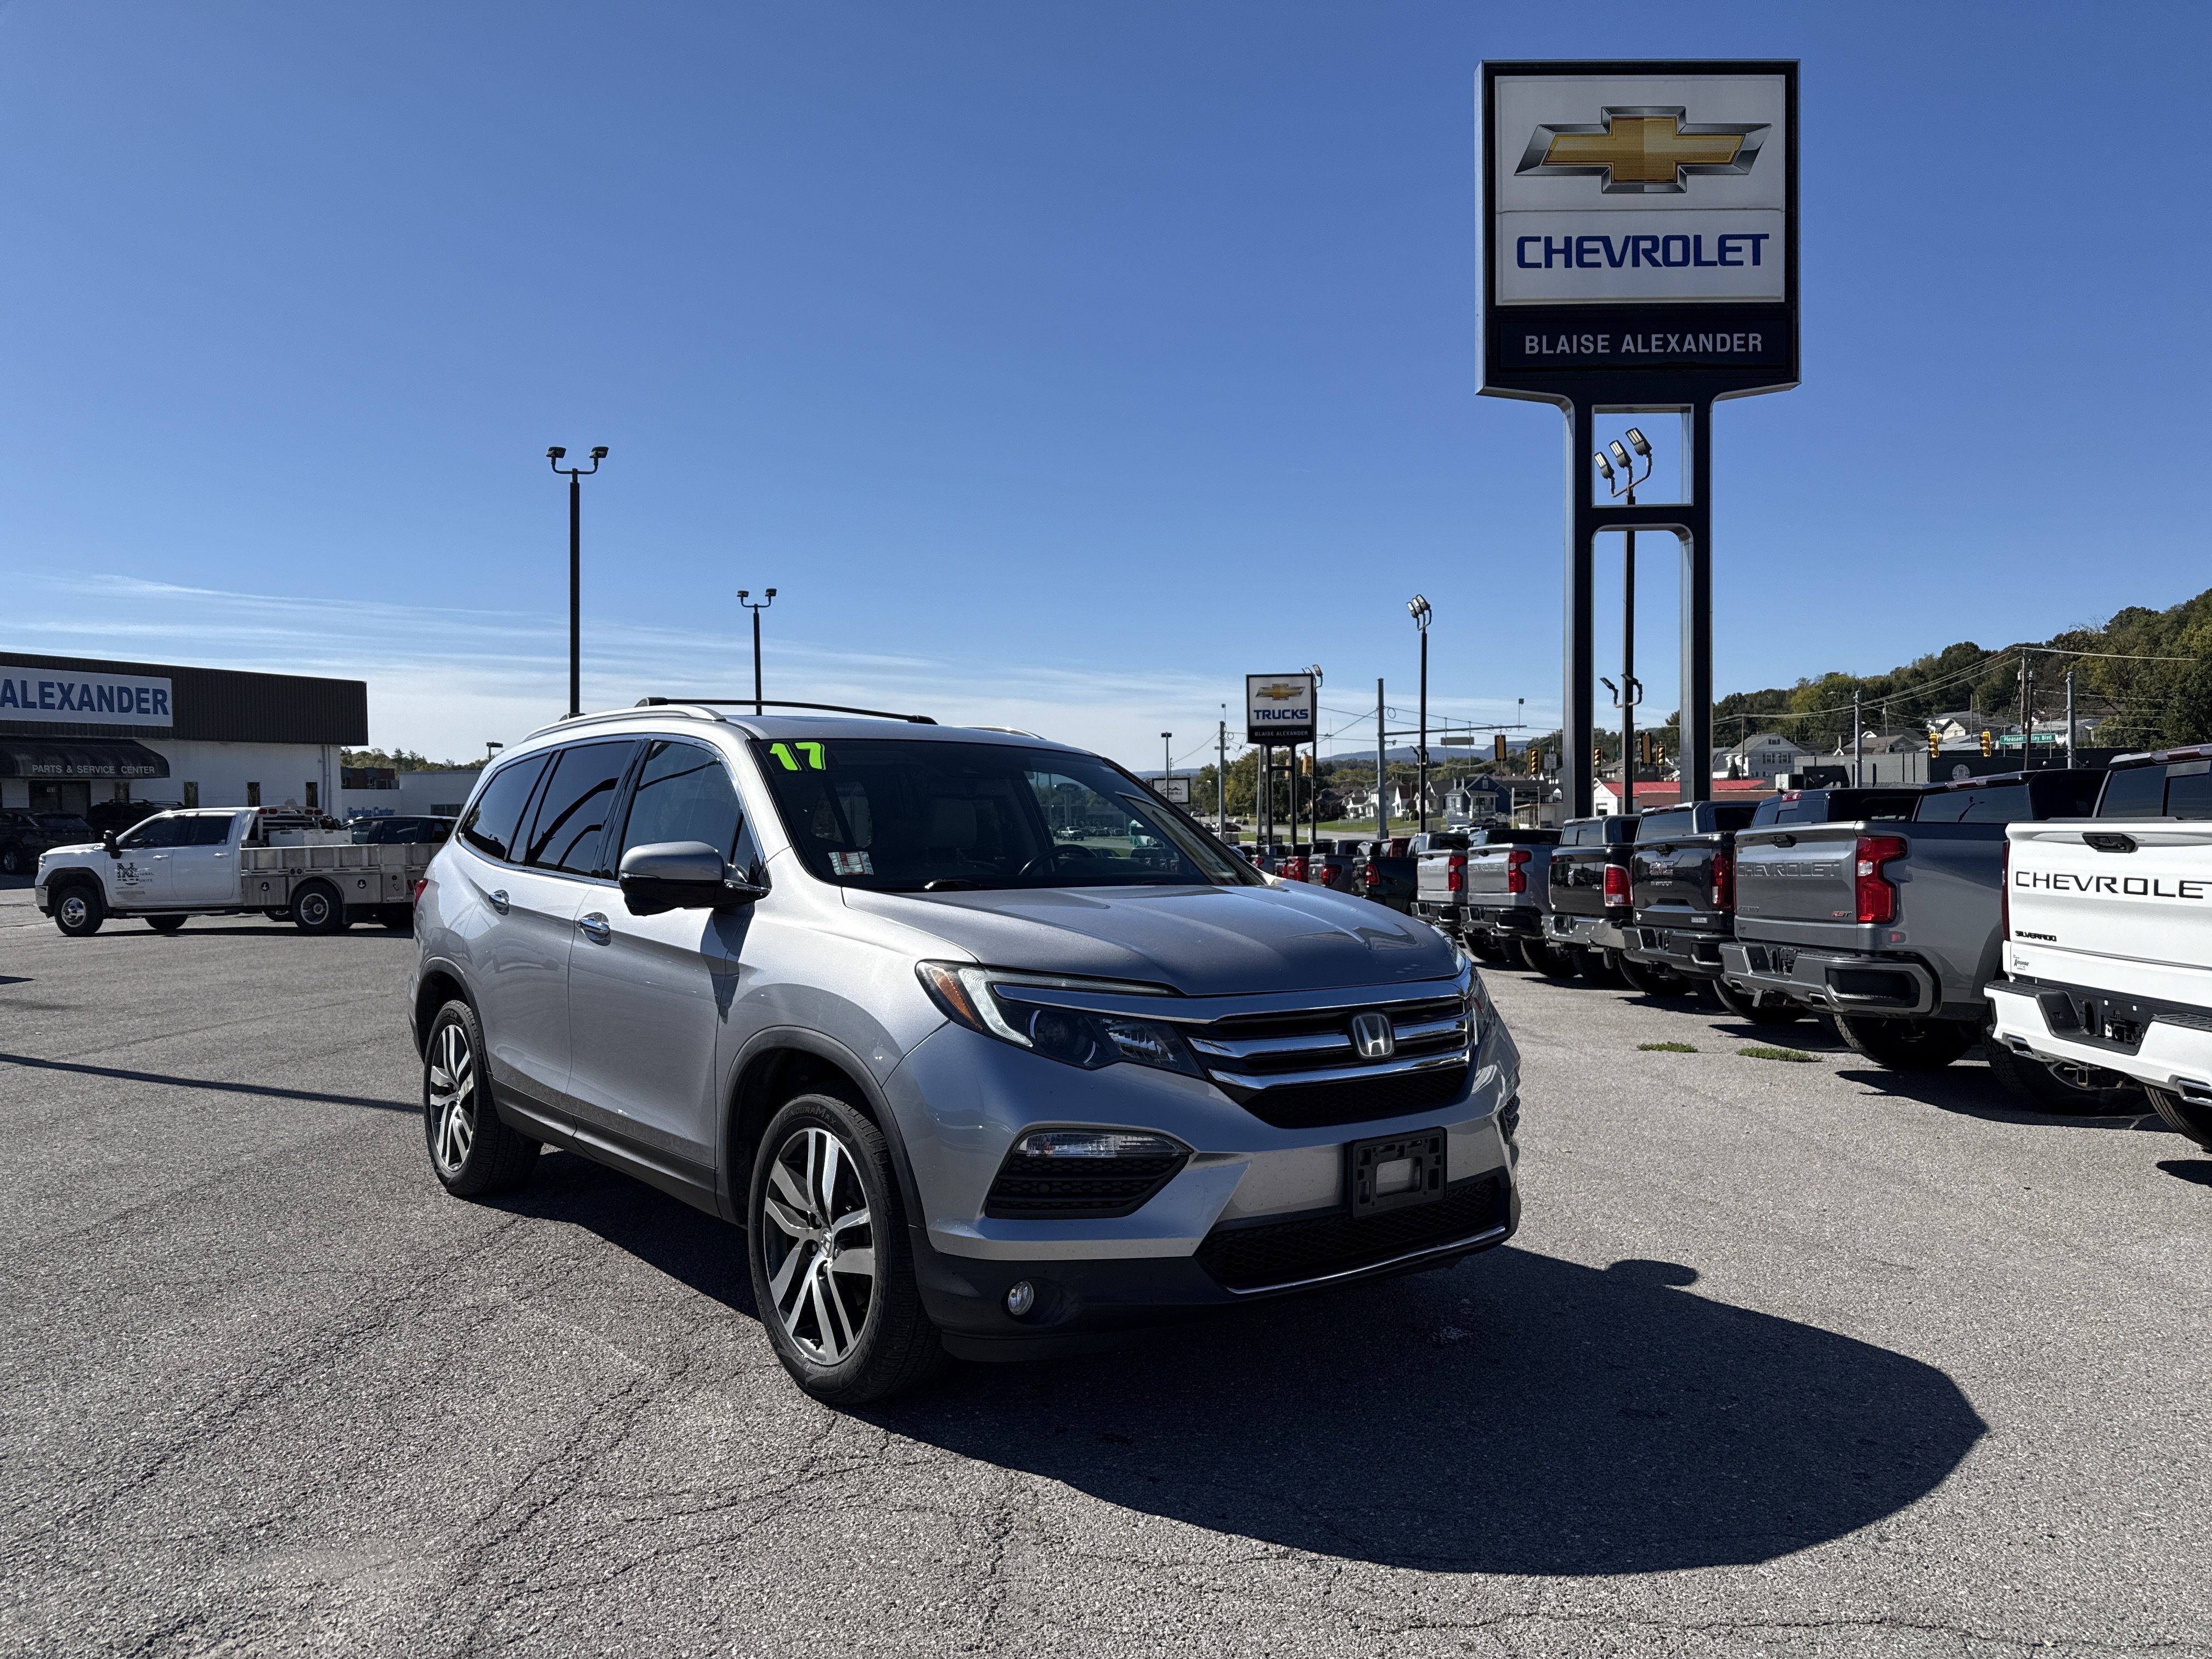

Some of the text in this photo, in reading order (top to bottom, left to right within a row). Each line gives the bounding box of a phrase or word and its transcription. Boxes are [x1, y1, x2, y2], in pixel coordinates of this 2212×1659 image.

[1517, 234, 1769, 268] CHEVROLET
[1525, 332, 1763, 354] BLAISE ALEXANDER
[0, 679, 170, 715] ALEXANDER
[1254, 709, 1309, 720] TRUCKS
[770, 742, 826, 771] 17
[32, 764, 155, 774] PARTS & SERVICE CENTER
[1737, 862, 1840, 877] CHEVROLET
[2015, 930, 2057, 942] SILVERADO
